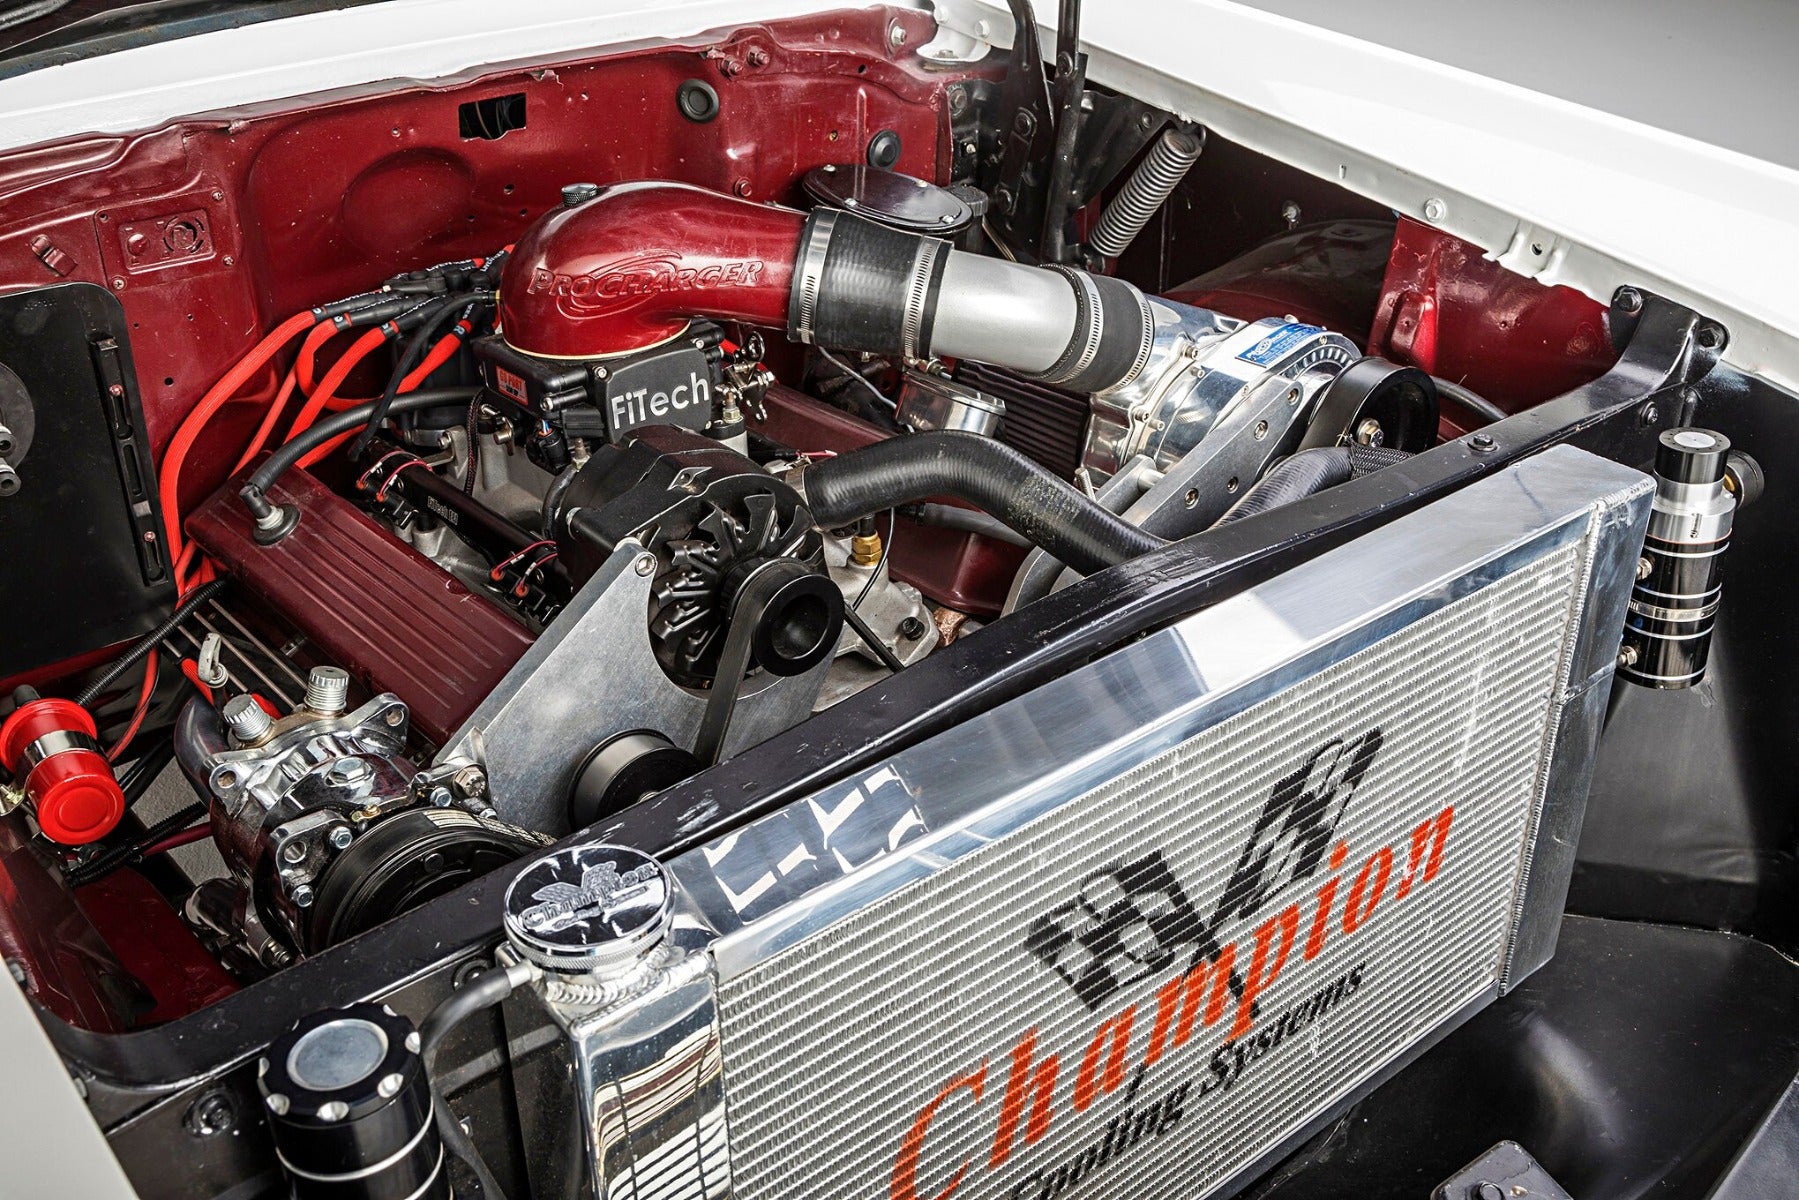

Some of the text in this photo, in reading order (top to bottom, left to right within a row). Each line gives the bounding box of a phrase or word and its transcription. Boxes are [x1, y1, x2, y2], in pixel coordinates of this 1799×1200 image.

[526, 260, 764, 298] PROCHARGER
[611, 371, 710, 430] FiTech
[889, 805, 1455, 1200] Champion
[1199, 961, 1366, 1093] Systems
